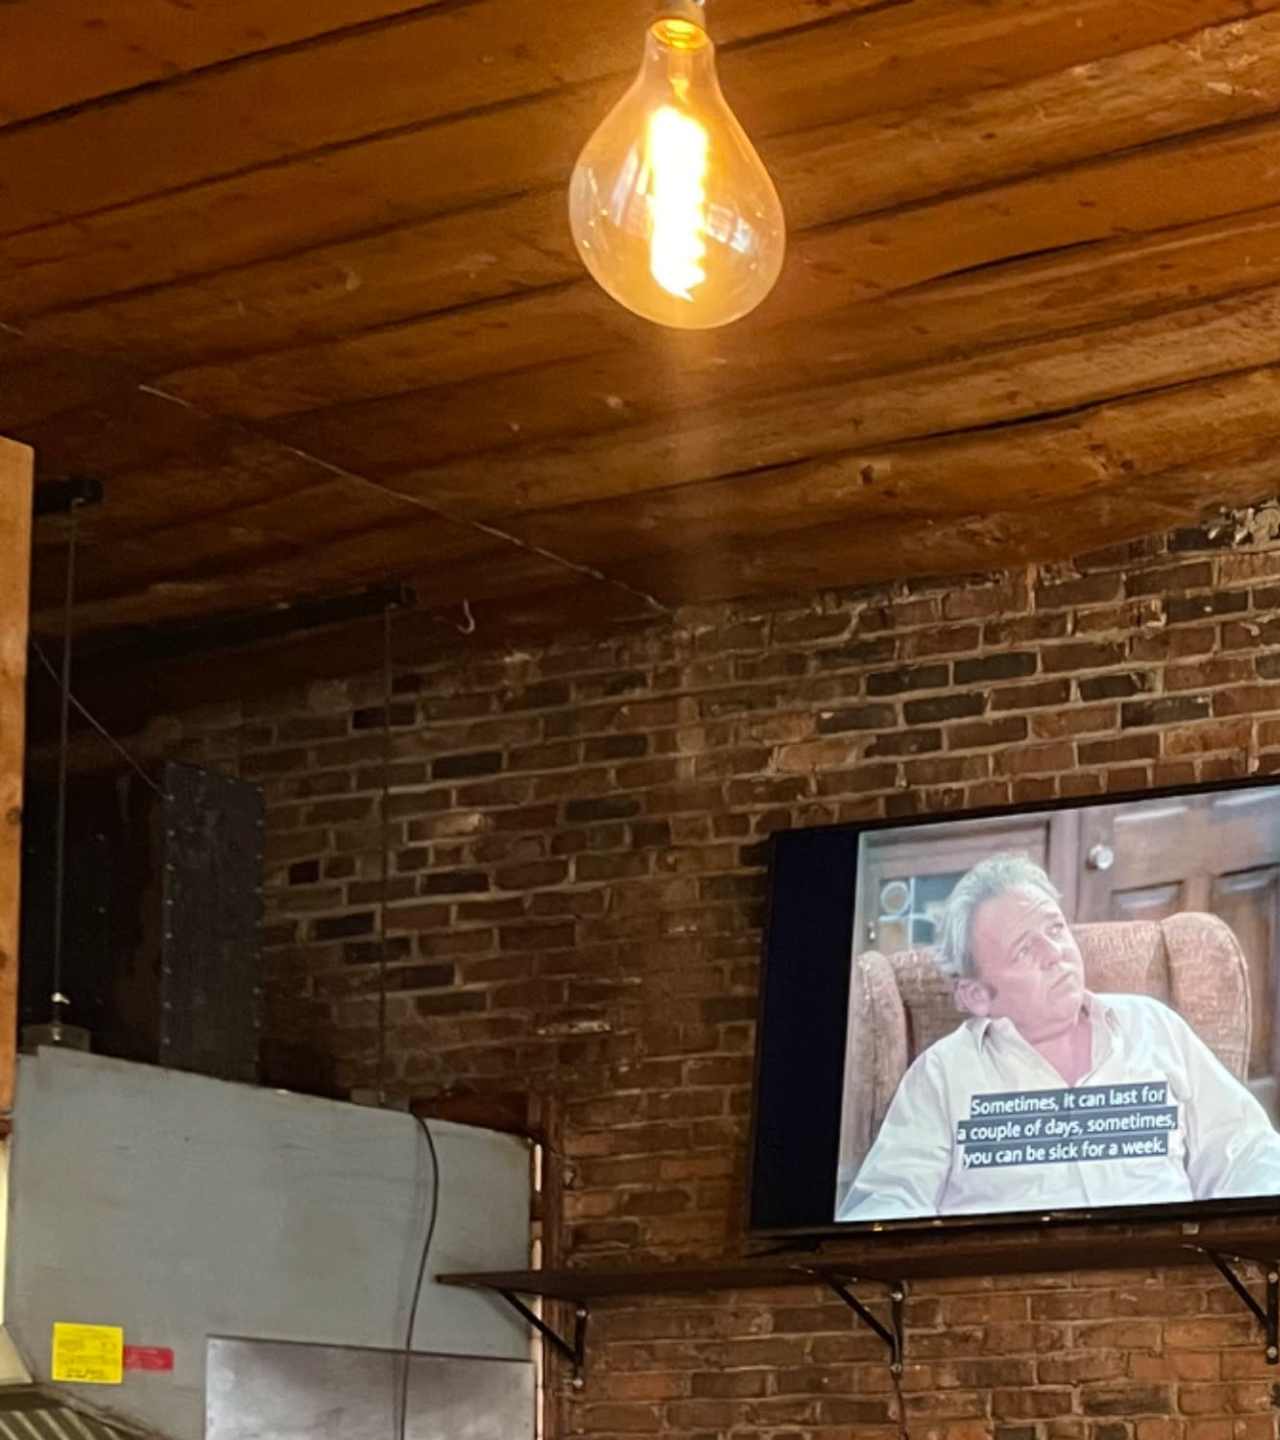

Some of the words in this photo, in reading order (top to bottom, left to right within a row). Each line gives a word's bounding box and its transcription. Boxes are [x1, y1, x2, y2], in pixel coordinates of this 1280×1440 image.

[971, 1095, 1059, 1115] Sometimes,
[1064, 1093, 1076, 1108] it
[1079, 1094, 1106, 1108] can
[1109, 1089, 1137, 1105] last
[1141, 1086, 1165, 1102] for
[957, 1129, 966, 1141] a
[970, 1121, 1020, 1141] couple
[1024, 1119, 1042, 1136] of
[1045, 1118, 1083, 1138] days,
[1087, 1112, 1175, 1132] sometimes,
[963, 1150, 992, 1168] you
[996, 1148, 1022, 1163] can
[1026, 1144, 1045, 1161] be
[1048, 1141, 1078, 1159] sick
[1082, 1140, 1104, 1157] for
[1108, 1143, 1118, 1155] a
[1121, 1137, 1166, 1154] week.
